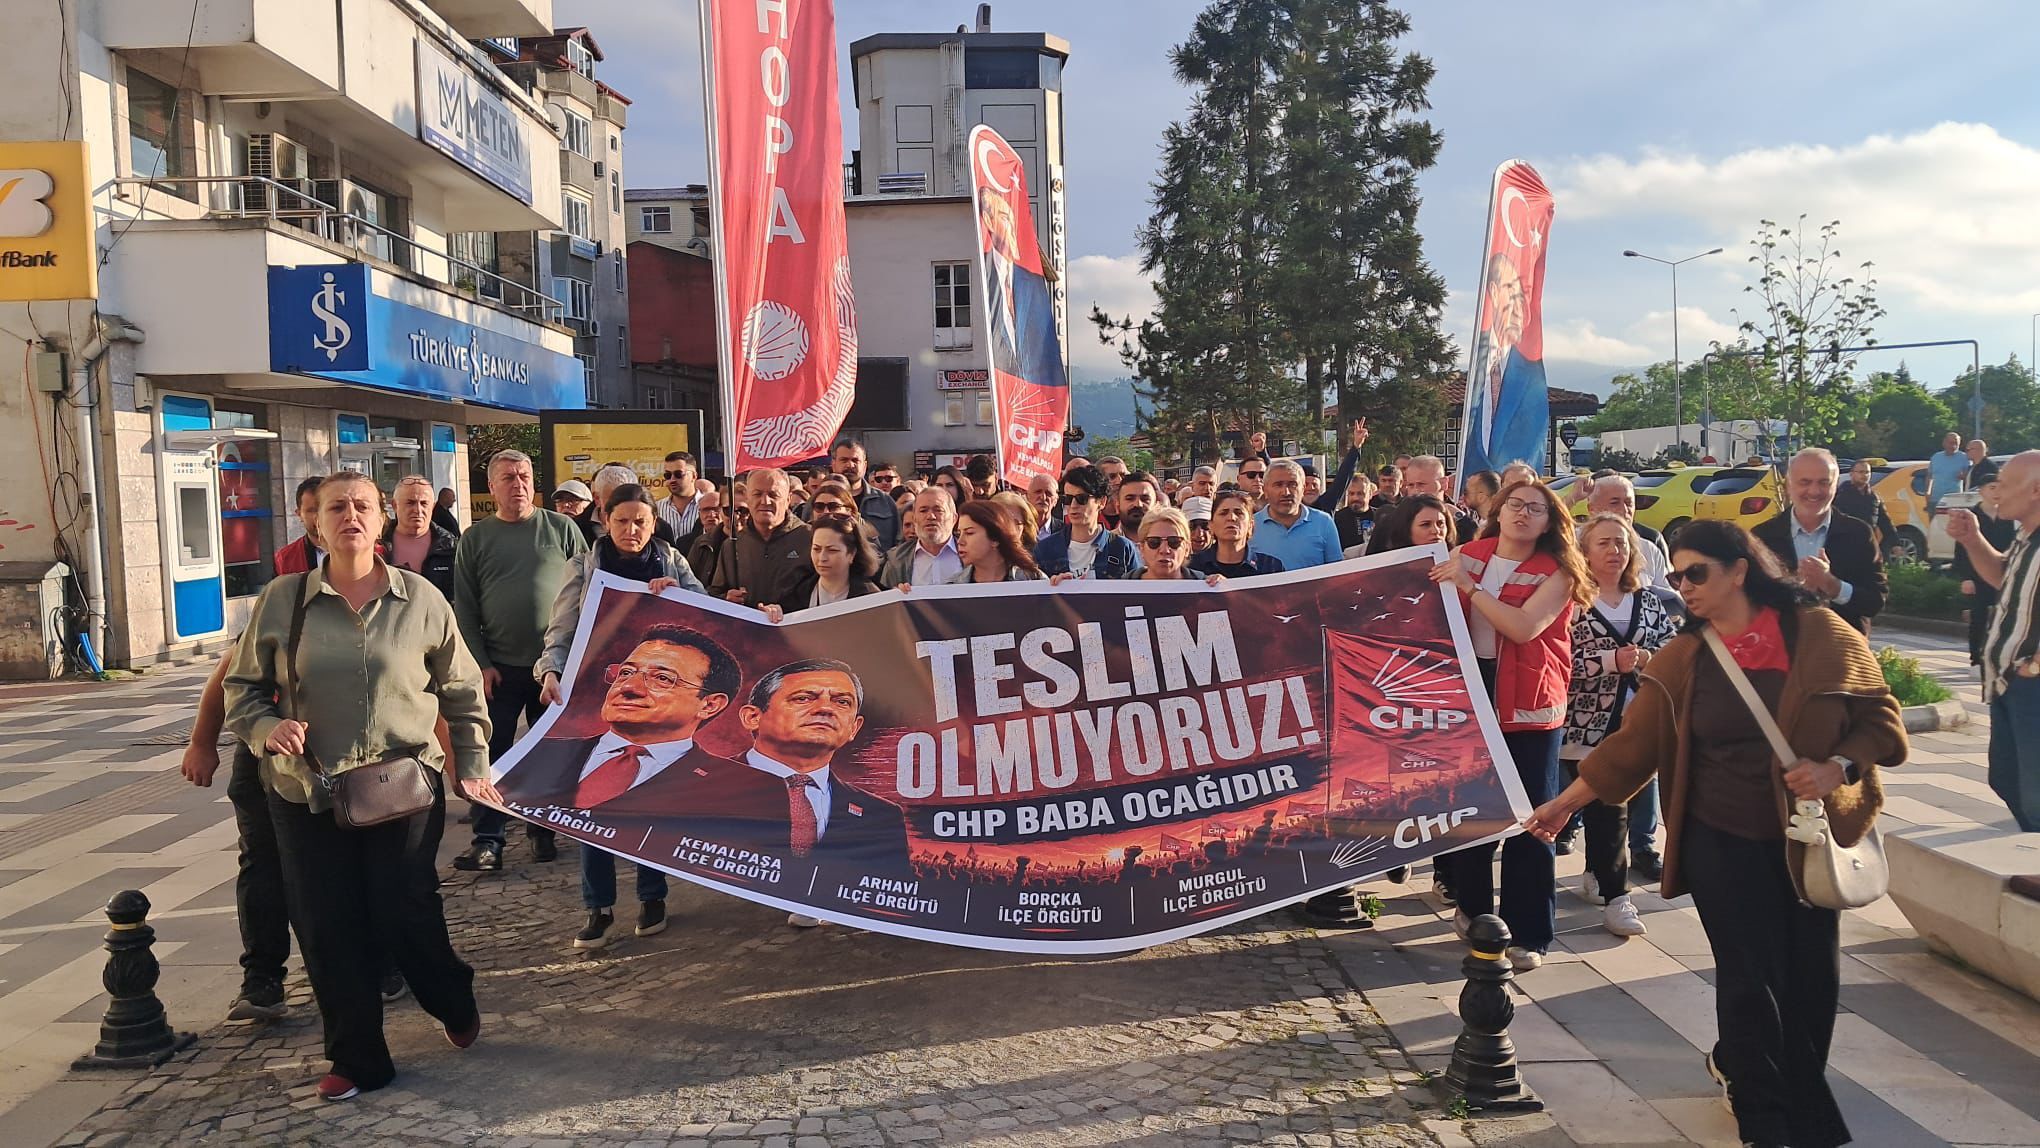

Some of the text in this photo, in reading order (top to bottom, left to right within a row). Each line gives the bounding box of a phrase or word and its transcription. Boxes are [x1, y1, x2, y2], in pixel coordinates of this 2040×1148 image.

[466, 90, 520, 165] METEN
[755, 0, 805, 244] HOPA
[0, 250, 58, 268] fBank
[409, 328, 469, 372] TÜRKİYE
[481, 352, 530, 385] BANKASI
[1009, 423, 1062, 453] CHP
[915, 605, 1243, 724] TESLİM
[1369, 705, 1467, 730] CHP
[895, 675, 1321, 800] OLMUYORUZ!
[1400, 760, 1437, 769] CHP
[933, 764, 1300, 838] CHP BABA OCAĞIDIR
[548, 810, 617, 839] ÖRGÜTÜ
[1393, 806, 1479, 849] CHP
[672, 846, 781, 883] İLÇE ÖRGÜTÜ
[680, 836, 782, 869] KEMALPAŞA
[859, 875, 919, 895] ARHAVİ
[1163, 876, 1267, 914] İLÇE ÖRGÜTÜ
[1178, 868, 1247, 893] MURGUL
[837, 885, 939, 914] İLÇE ÖRGÜTÜ
[1019, 892, 1082, 908] BORÇKA
[998, 906, 1102, 925] İLÇE ÖRGÜTÜ
